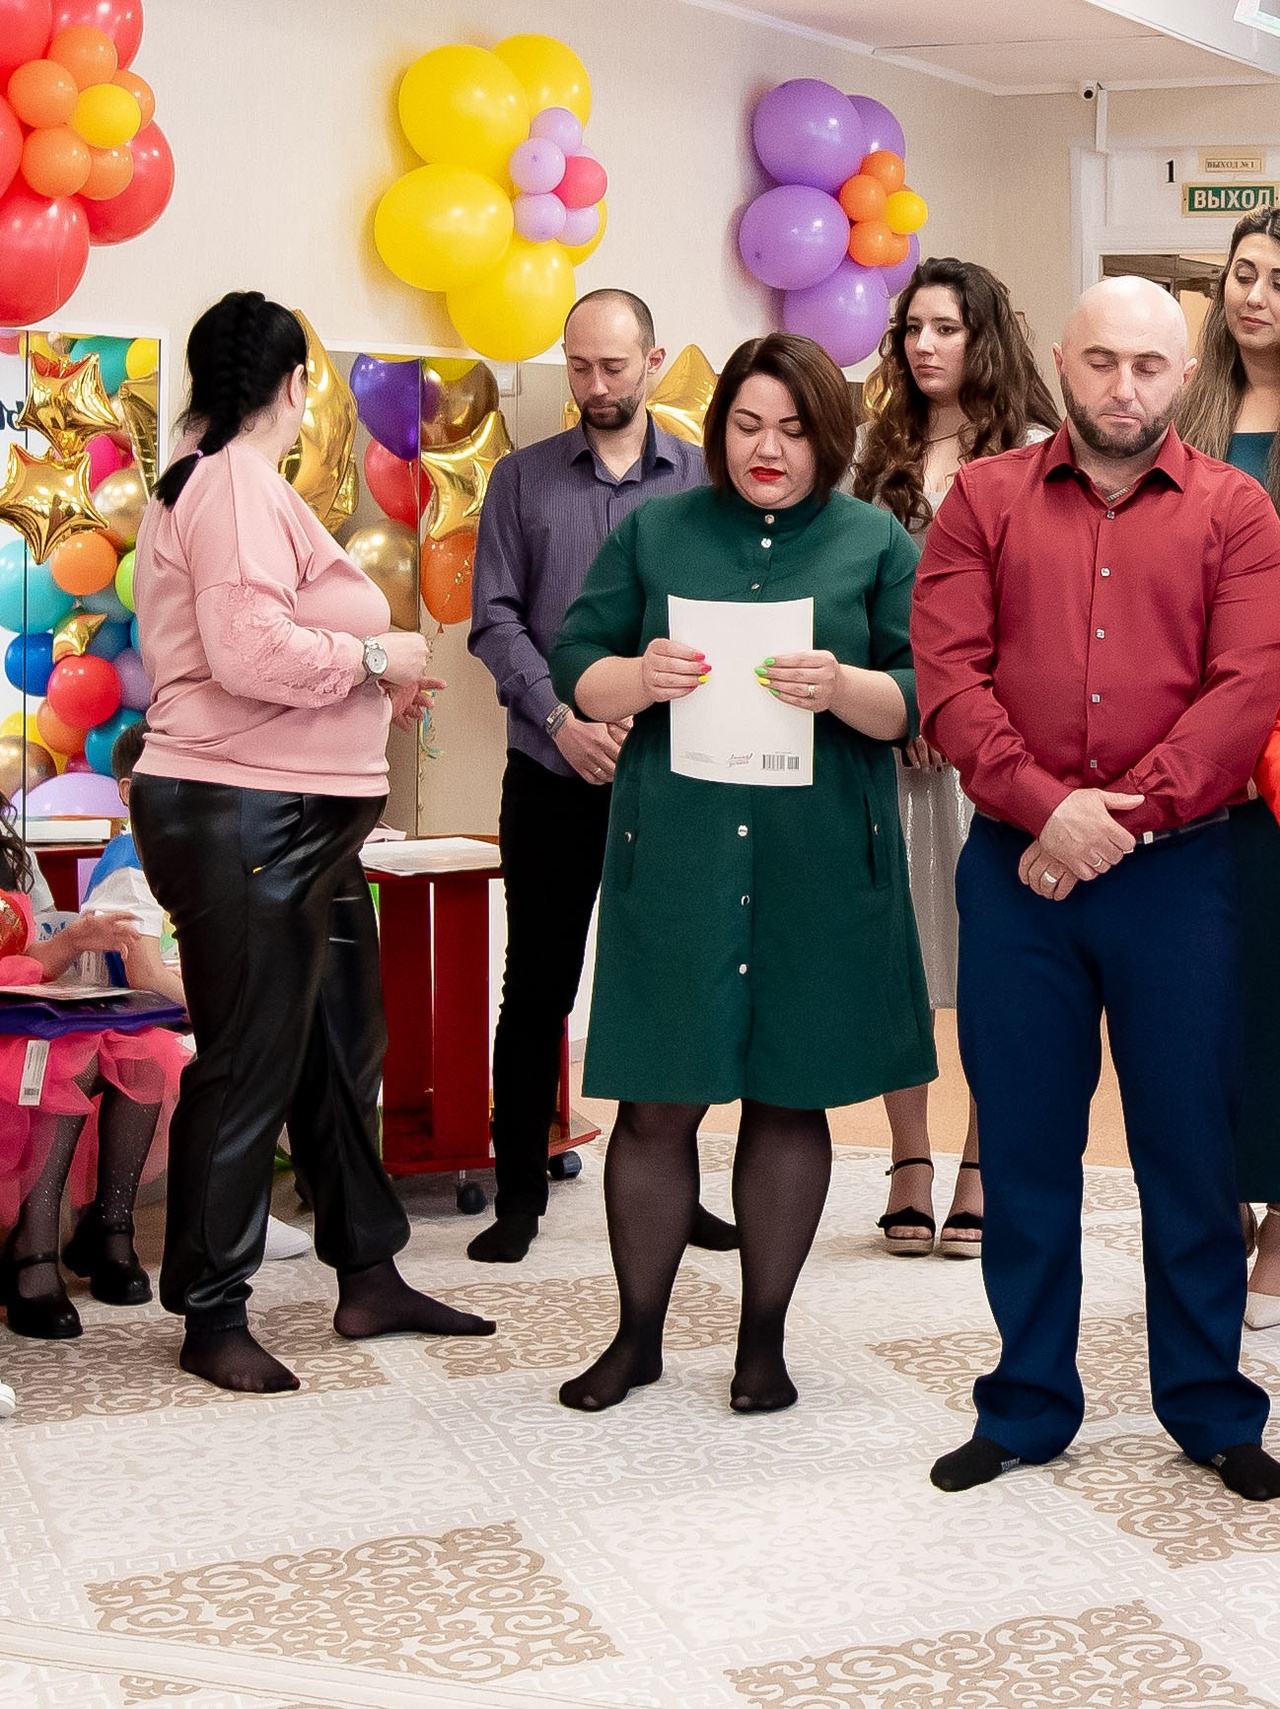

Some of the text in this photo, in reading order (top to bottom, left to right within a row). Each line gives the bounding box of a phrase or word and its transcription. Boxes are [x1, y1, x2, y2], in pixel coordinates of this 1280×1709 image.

[1165, 159, 1175, 183] 1
[1207, 161, 1238, 169] ВЫХОД
[1194, 190, 1270, 208] ВЫХОД
